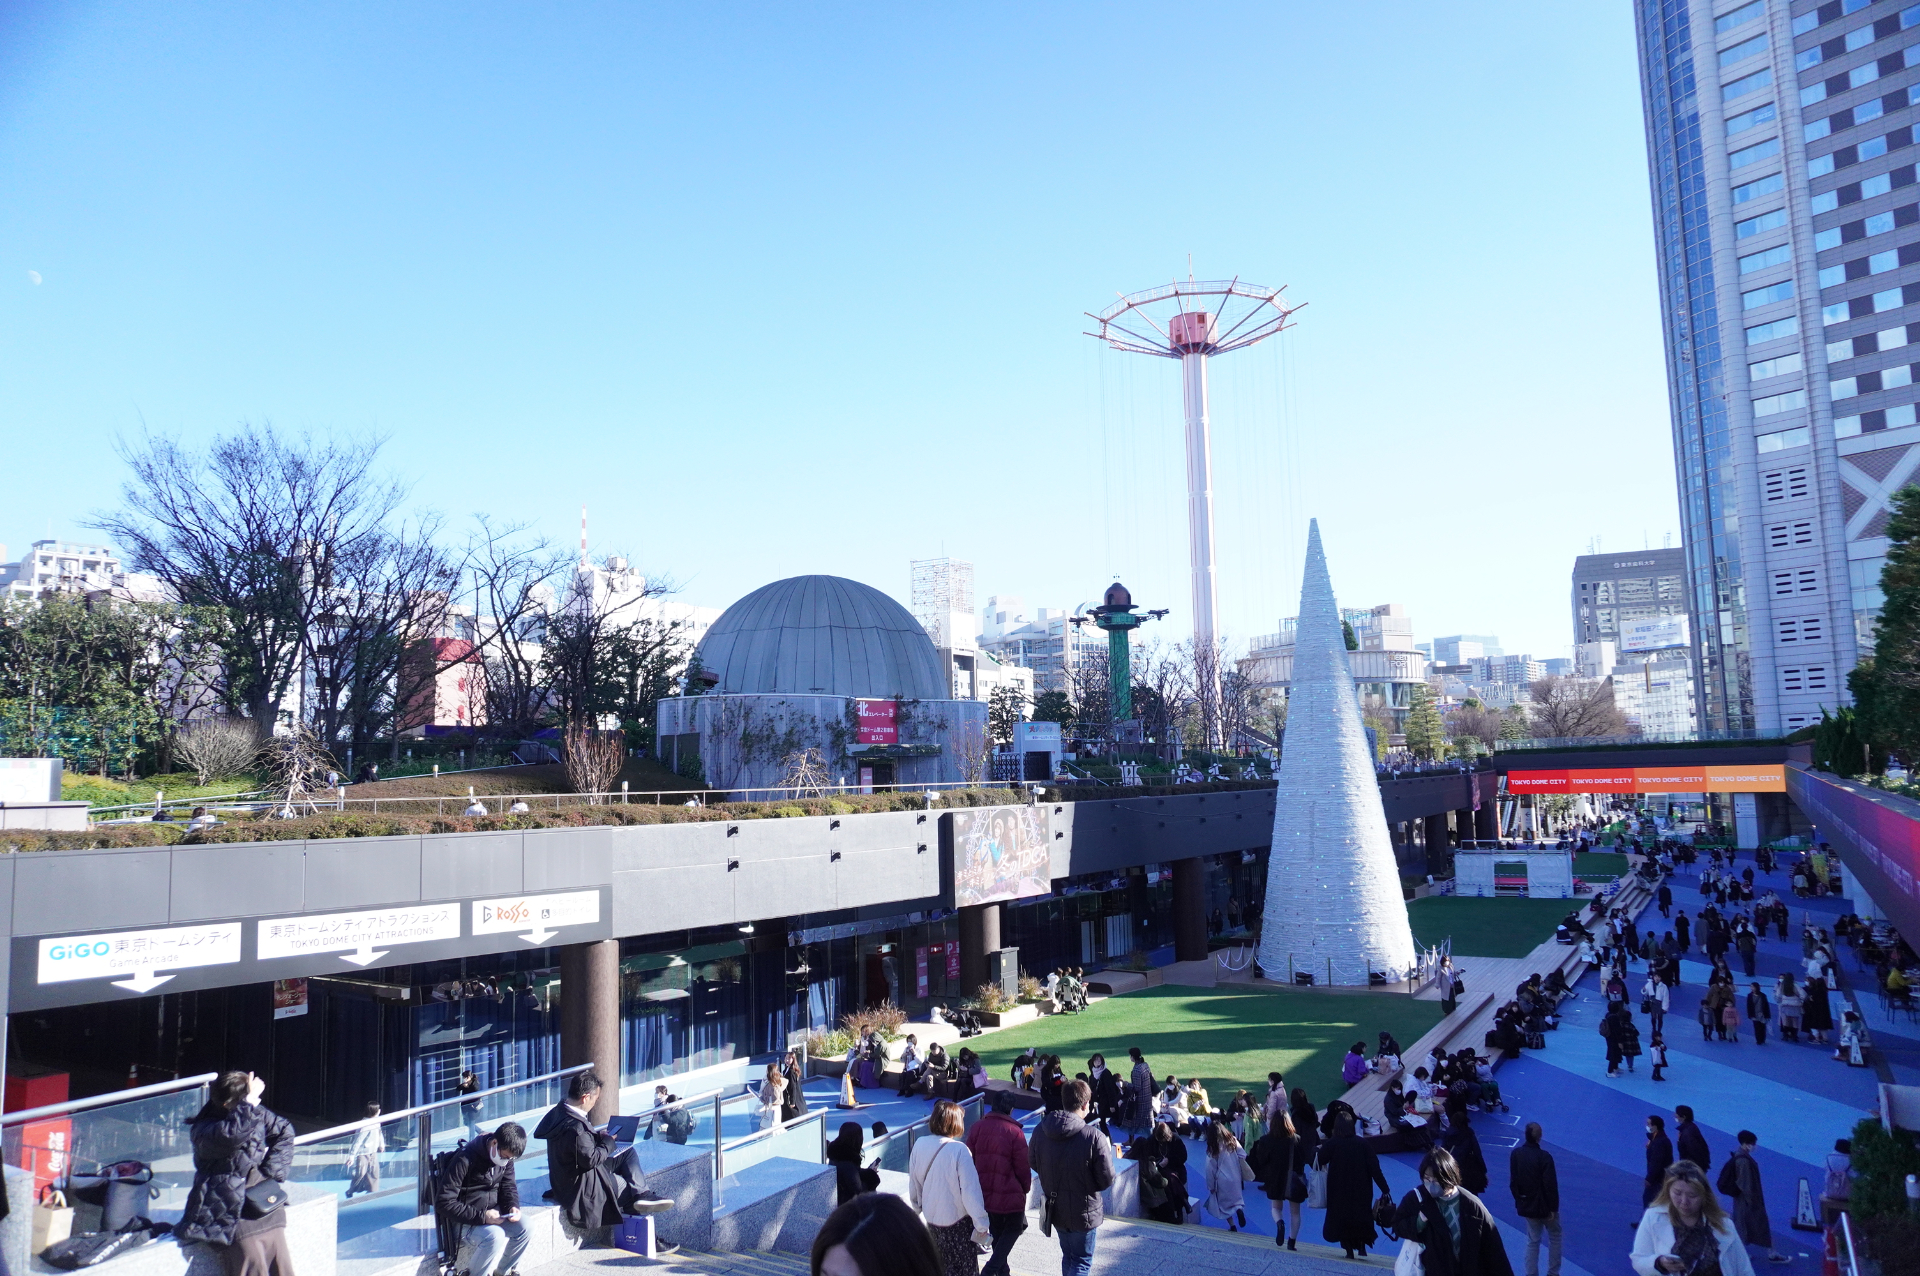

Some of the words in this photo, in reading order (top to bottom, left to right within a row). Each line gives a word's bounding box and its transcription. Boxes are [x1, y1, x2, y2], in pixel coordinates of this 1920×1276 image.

[857, 701, 869, 717] 北
[496, 900, 530, 924] ROSSO
[269, 918, 363, 939] 東京ドームシティ
[290, 939, 320, 949] TOKYO
[322, 935, 349, 946] DOME
[352, 932, 373, 942] CITY
[374, 926, 434, 940] ATTRACTIONS
[48, 941, 111, 961] GiGO
[114, 931, 232, 954] 東京ドームシティ
[947, 943, 953, 955] P
[109, 958, 140, 968] Game
[141, 953, 180, 965] Arcade
